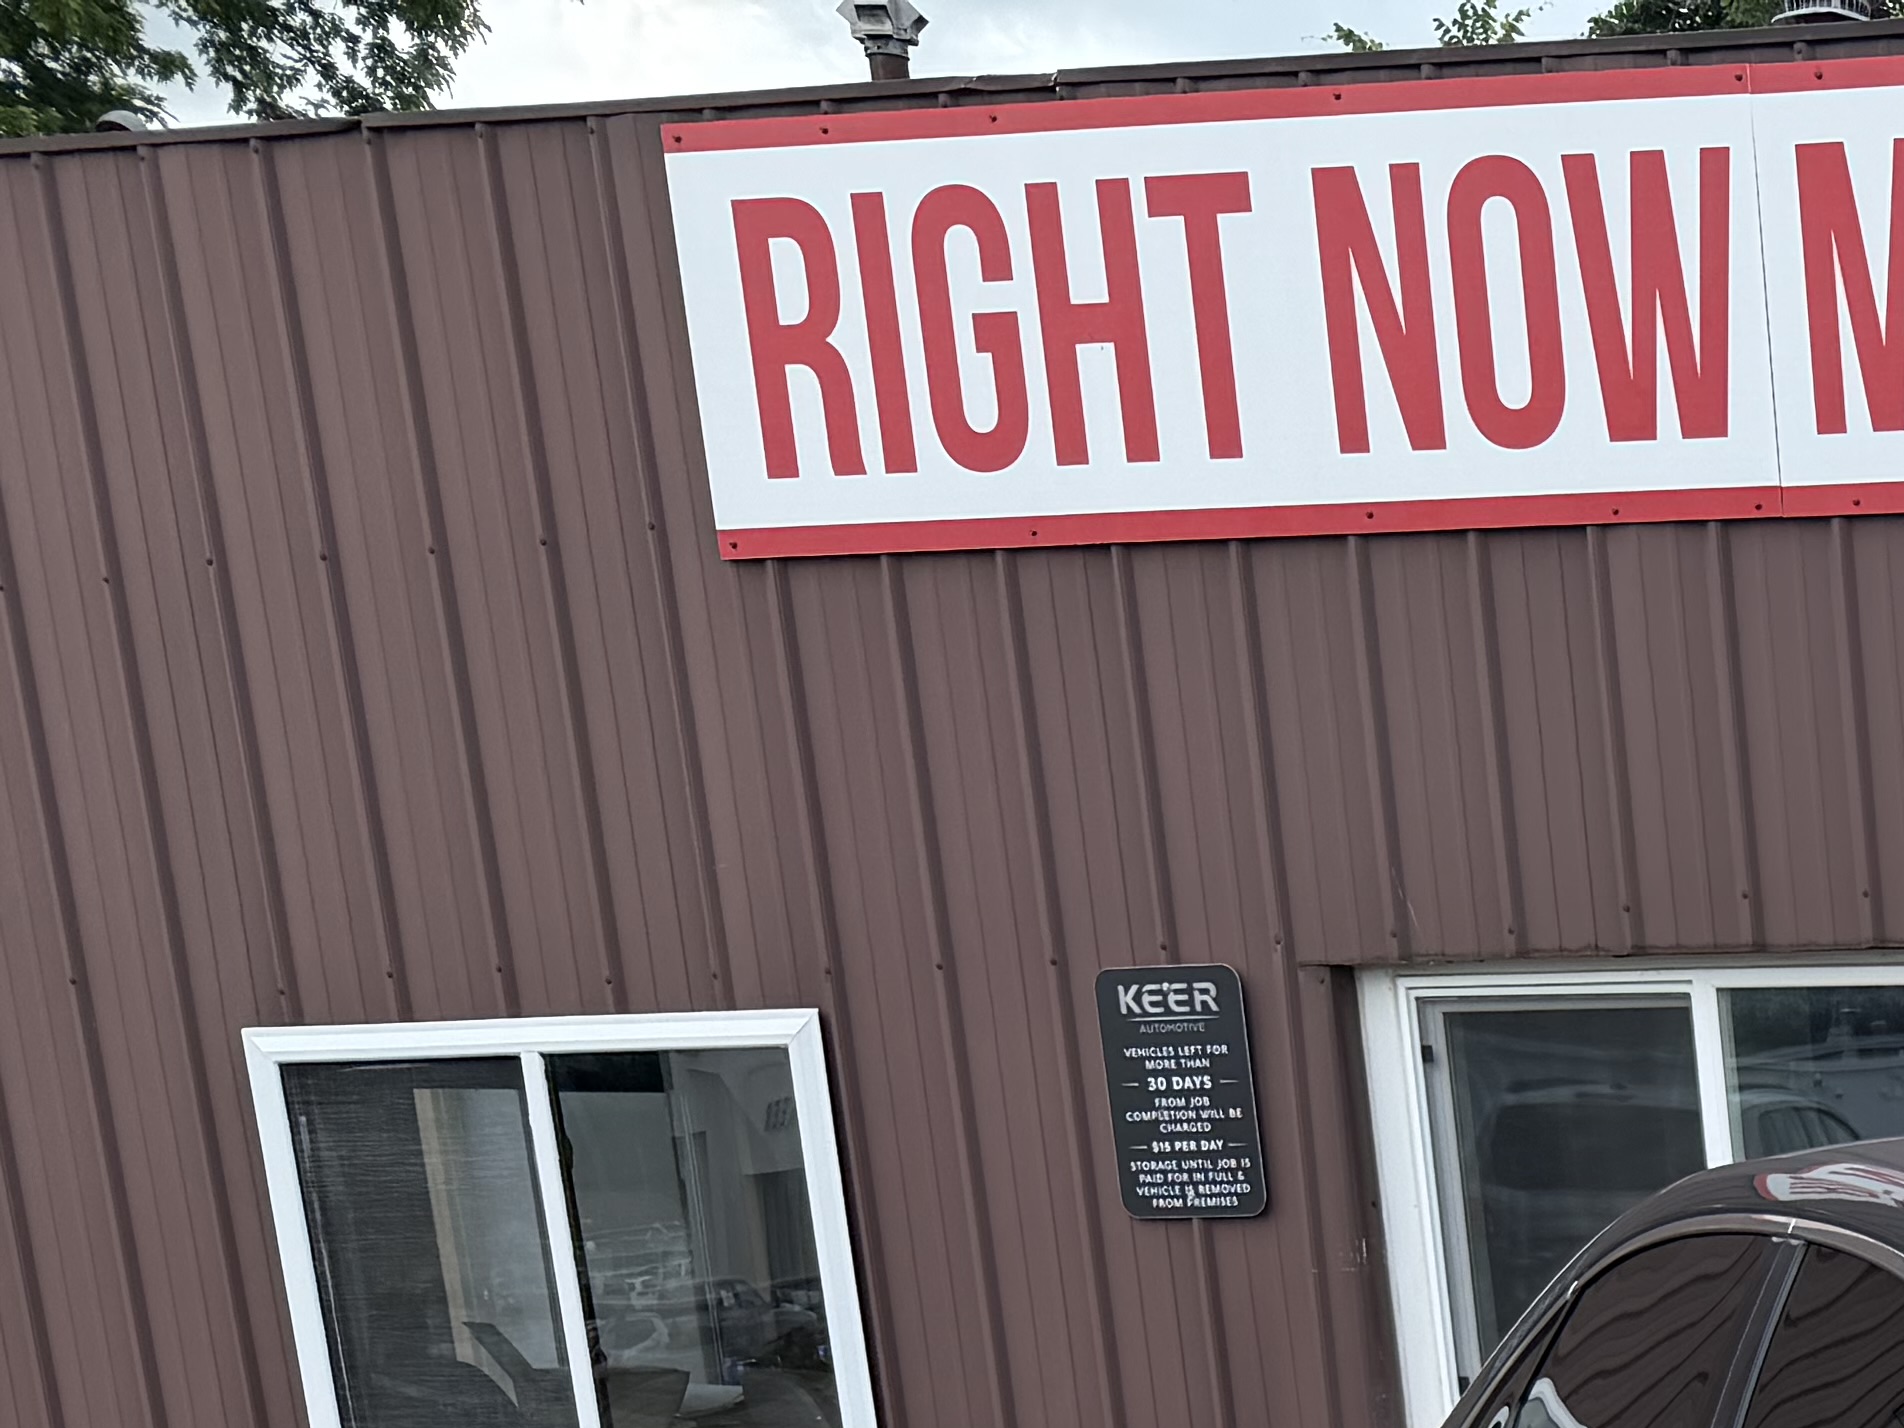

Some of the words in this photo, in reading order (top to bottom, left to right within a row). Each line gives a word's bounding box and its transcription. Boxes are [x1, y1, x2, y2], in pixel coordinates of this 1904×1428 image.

[731, 168, 1252, 481] RIGHT
[1310, 146, 1729, 455] NOW
[1117, 982, 1220, 1014] KEER
[1140, 1022, 1206, 1034] AUTOMOTIVE
[1123, 1046, 1175, 1058] VEHICLES
[1178, 1045, 1202, 1056] LEFT
[1206, 1044, 1229, 1055] FOR
[1145, 1059, 1178, 1070] MORE
[1180, 1058, 1211, 1069] THAN
[1147, 1076, 1167, 1091] 30
[1171, 1075, 1213, 1090] DAYS
[1154, 1097, 1186, 1108] FROM
[1190, 1096, 1211, 1108] JOB
[1125, 1110, 1197, 1122] COMPLETION
[1200, 1109, 1225, 1119] WILL
[1229, 1107, 1244, 1119] BE
[1160, 1122, 1212, 1133] CHARGED
[1174, 1140, 1198, 1152] PER
[1200, 1139, 1224, 1151] DAY
[1130, 1160, 1179, 1172] STORAGE
[1181, 1159, 1213, 1170] UNTIL
[1216, 1158, 1237, 1170] JOB
[1240, 1158, 1251, 1168] IS
[1139, 1173, 1164, 1183] PAID
[1168, 1172, 1190, 1182] FOR
[1208, 1171, 1233, 1181] FULL
[1136, 1185, 1181, 1197] VEHICLE
[1198, 1183, 1251, 1194] REMOVED
[1152, 1198, 1184, 1208] FROM
